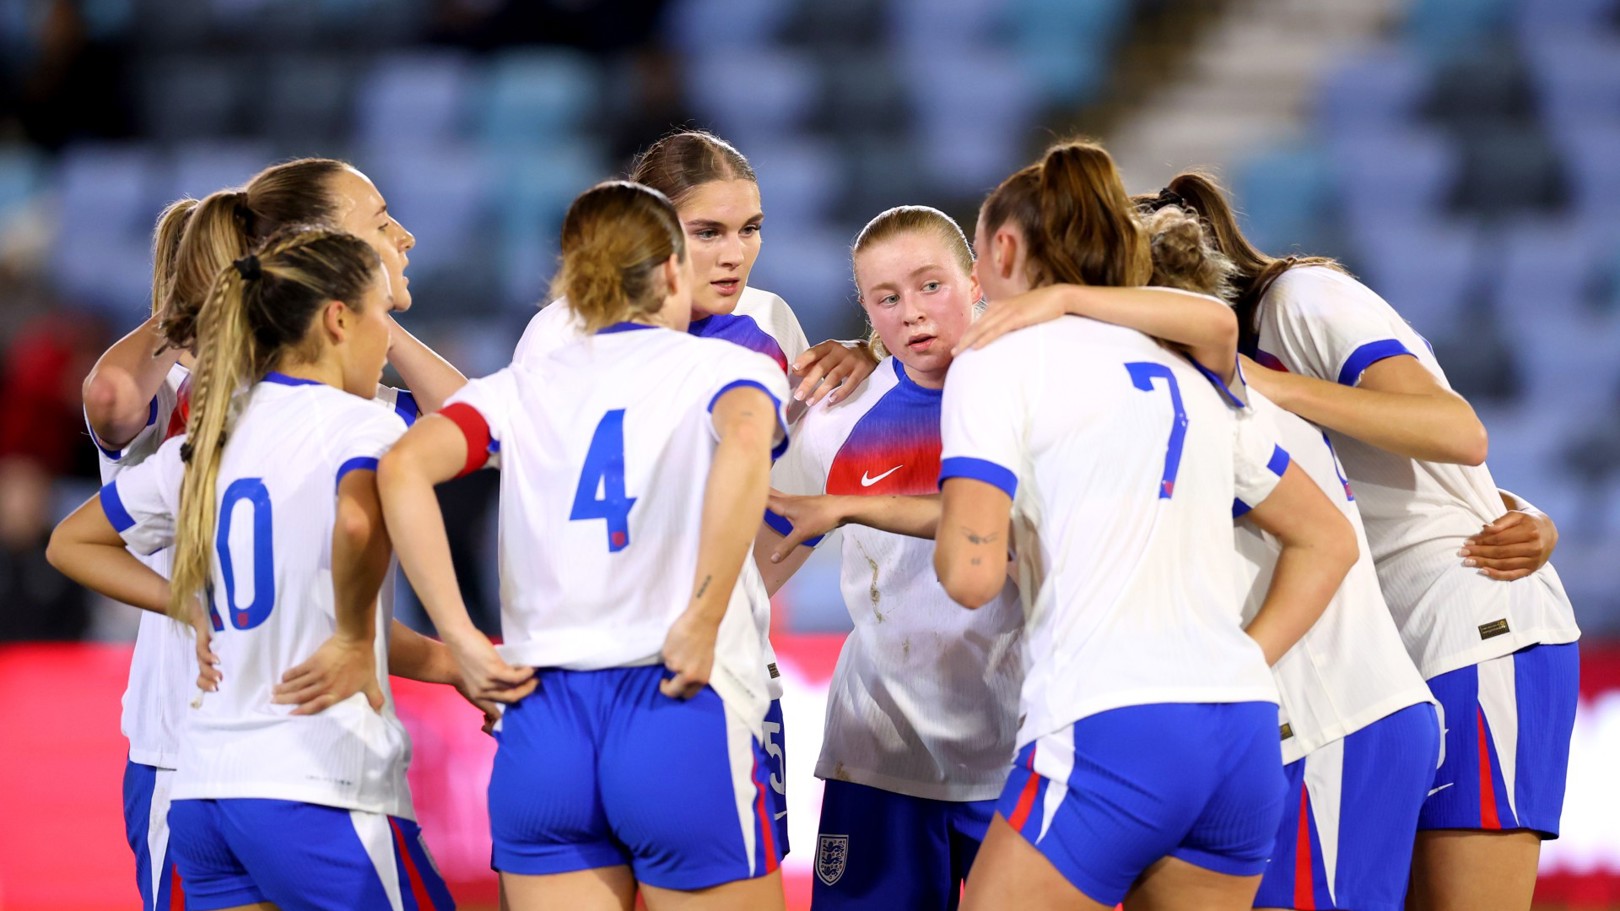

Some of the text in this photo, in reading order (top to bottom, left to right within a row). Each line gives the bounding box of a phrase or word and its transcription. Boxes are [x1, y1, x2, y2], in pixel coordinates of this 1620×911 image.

[569, 408, 638, 553] 4
[1123, 361, 1189, 500] 7
[763, 721, 786, 796] 5
